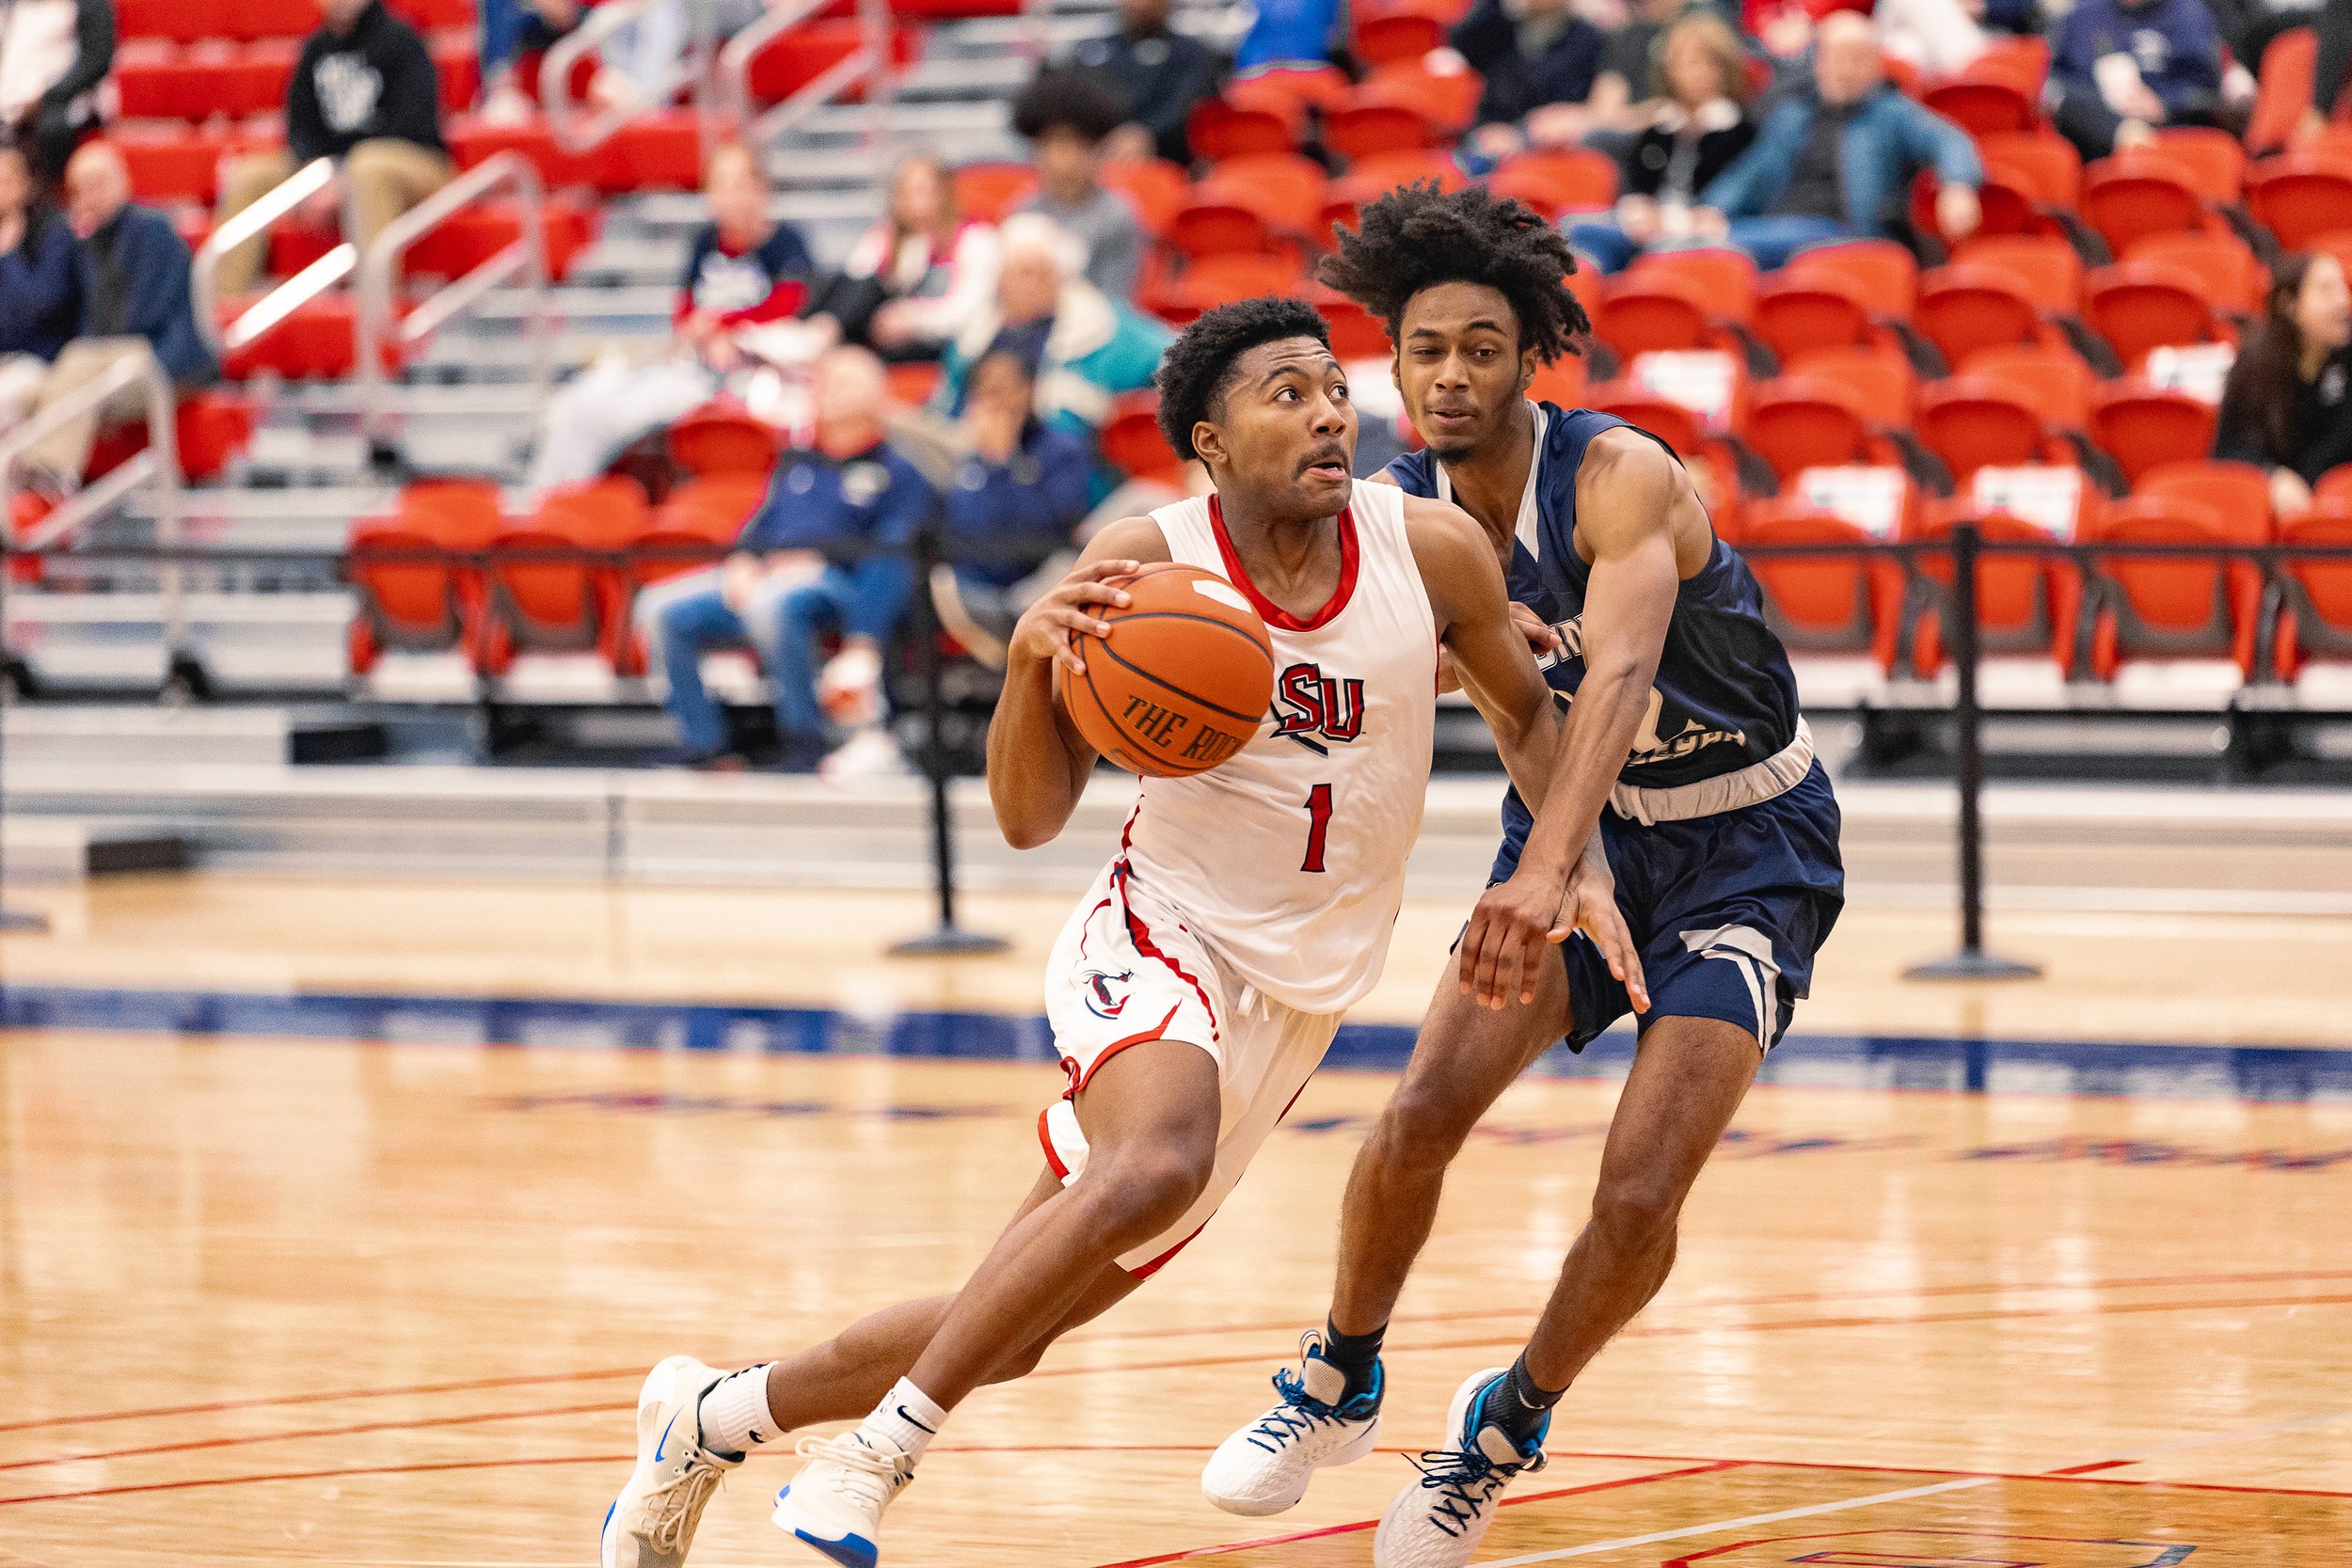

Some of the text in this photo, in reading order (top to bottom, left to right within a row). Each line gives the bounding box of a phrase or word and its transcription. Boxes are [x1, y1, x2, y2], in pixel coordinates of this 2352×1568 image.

[1122, 694, 1243, 761] THE ROC
[1274, 662, 1365, 743] SU
[1300, 783, 1333, 872] 1
